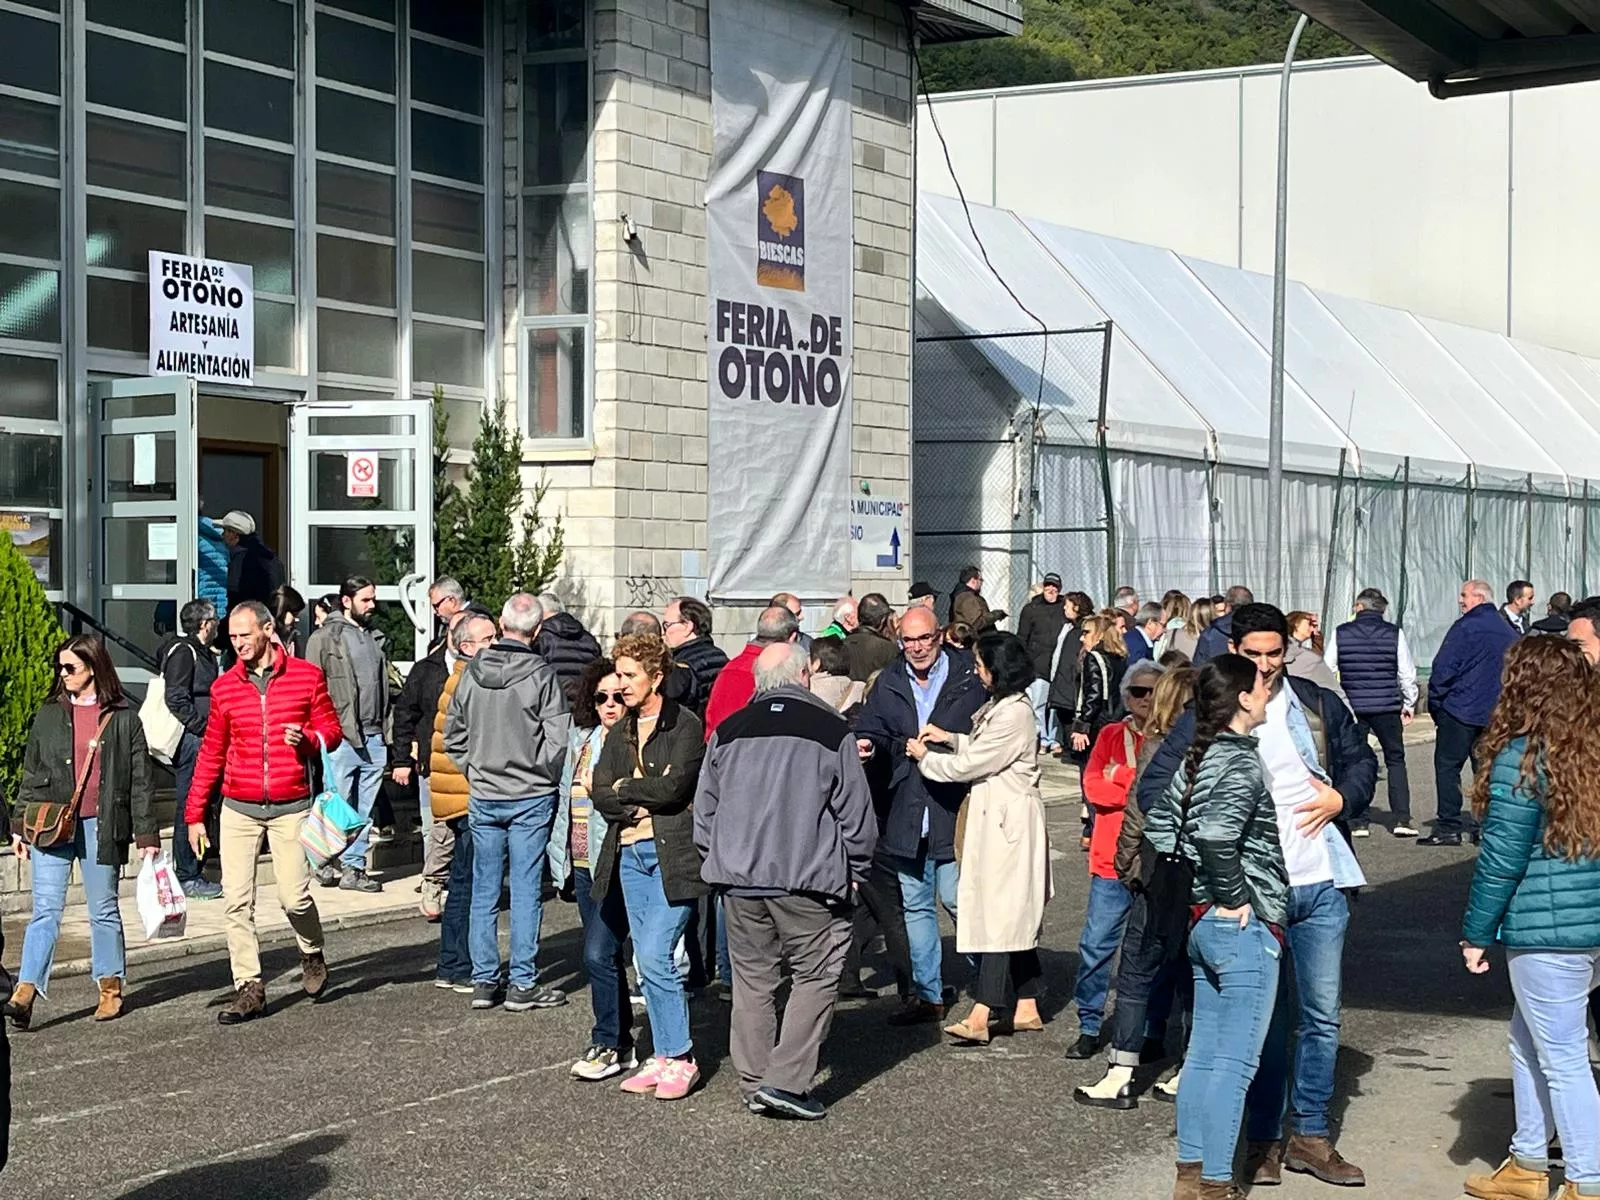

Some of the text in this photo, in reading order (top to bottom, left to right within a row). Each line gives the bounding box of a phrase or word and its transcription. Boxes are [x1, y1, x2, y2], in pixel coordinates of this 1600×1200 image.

[759, 240, 805, 267] BIESCAS
[162, 259, 224, 283] FERIA DE
[162, 278, 243, 309] OTOÑO
[169, 311, 240, 340] ARTESANÍA
[716, 298, 842, 356] FERIA DE
[201, 340, 209, 350] Y
[156, 349, 251, 380] ALIMENTACIÓN
[718, 340, 842, 408] OTOÑO
[857, 500, 902, 517] MUNICIPAL
